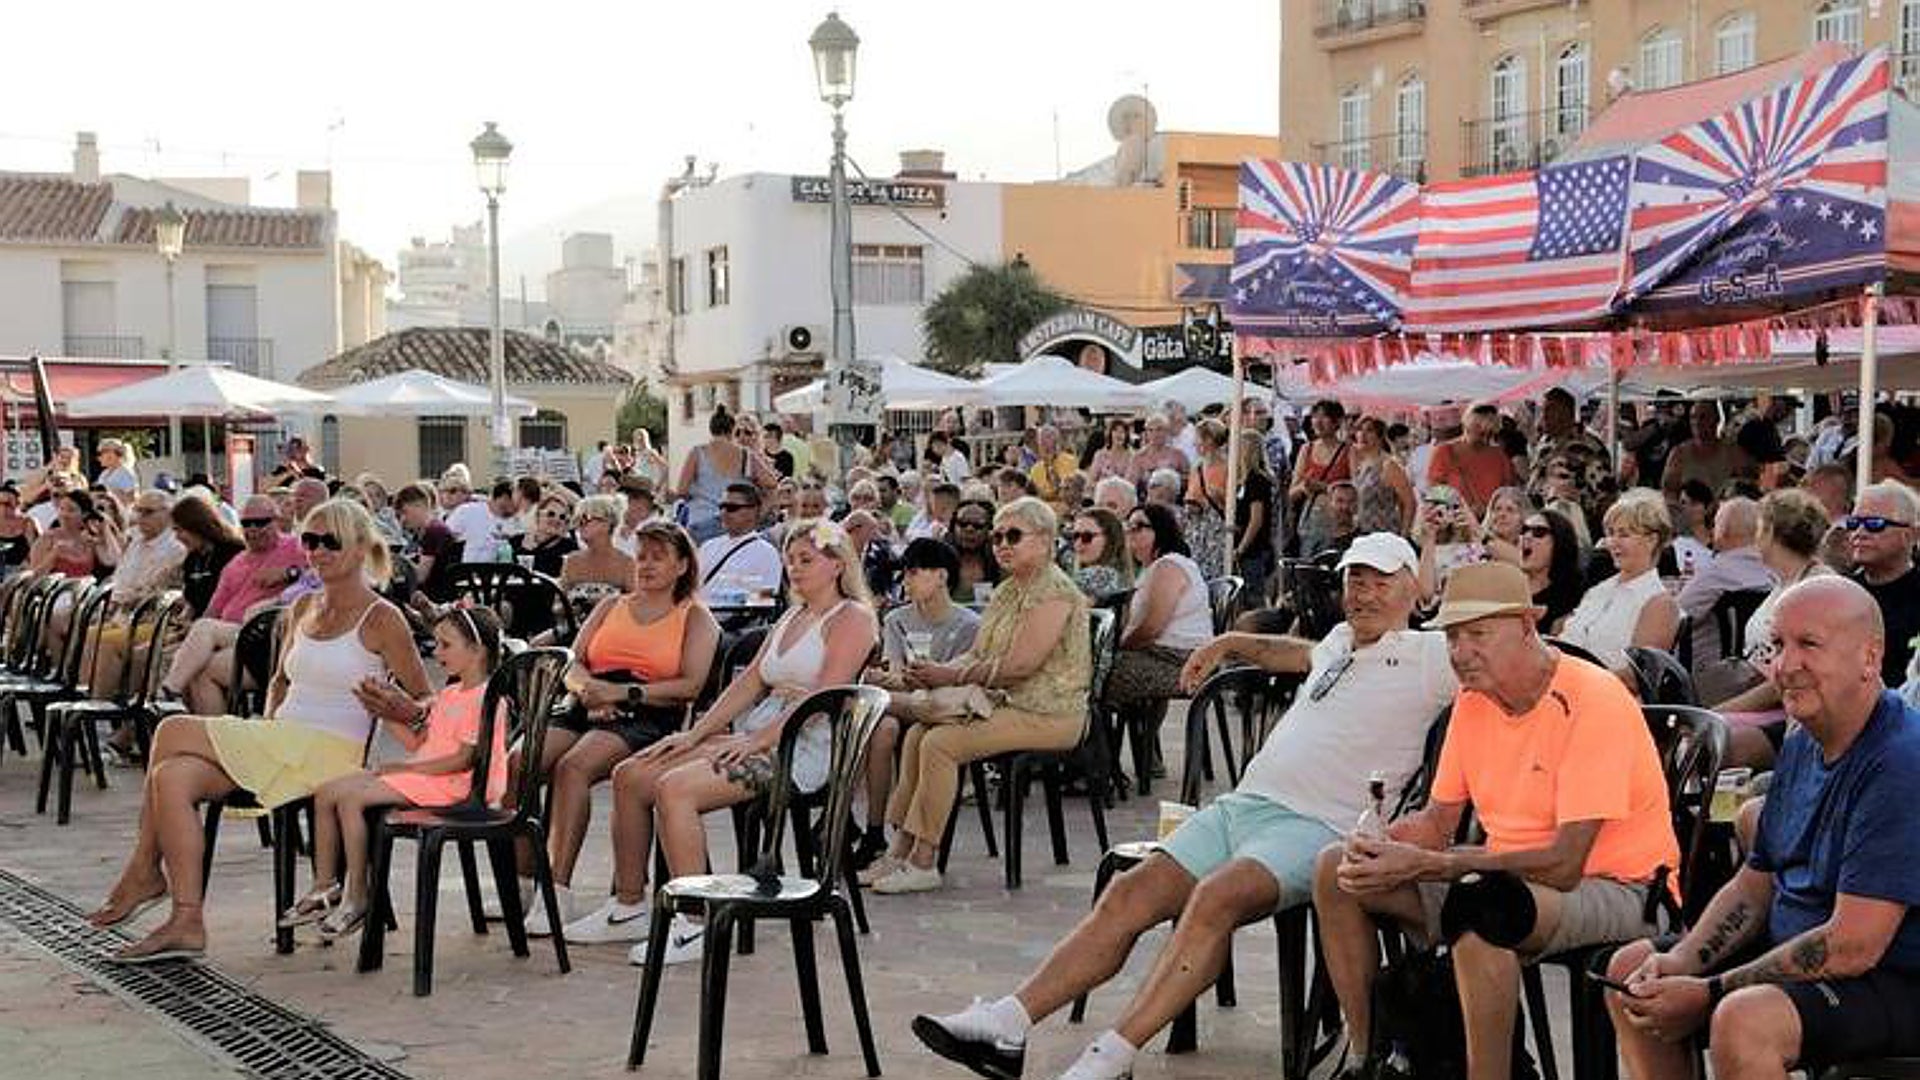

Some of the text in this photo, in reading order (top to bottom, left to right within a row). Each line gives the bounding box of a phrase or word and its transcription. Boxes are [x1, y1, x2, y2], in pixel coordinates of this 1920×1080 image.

[800, 181, 832, 194] CAS
[892, 185, 936, 200] PIZZA
[1144, 337, 1185, 361] Gata
